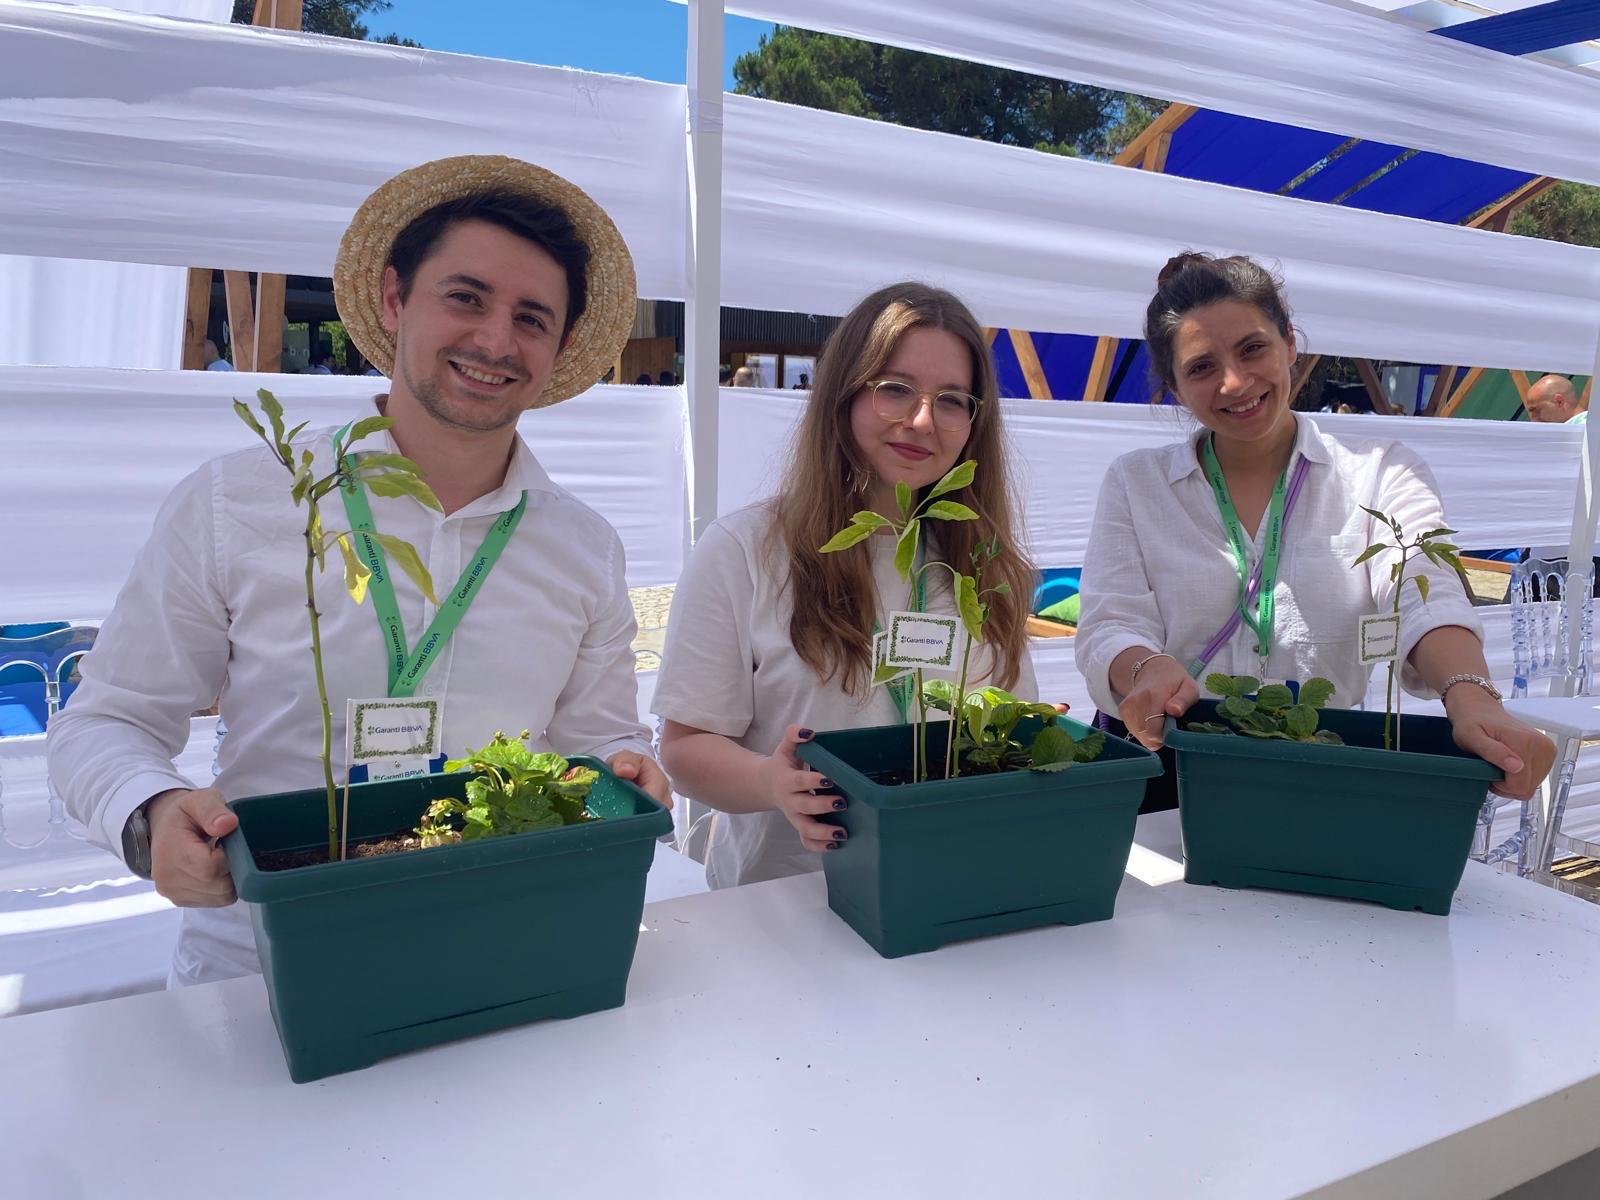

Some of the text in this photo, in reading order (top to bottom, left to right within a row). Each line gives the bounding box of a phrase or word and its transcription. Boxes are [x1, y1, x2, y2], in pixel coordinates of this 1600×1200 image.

[370, 559, 384, 583] BBVA
[458, 556, 488, 599] Garanti BBVA
[391, 624, 404, 675] Garanti BBV
[407, 632, 441, 678] Garanti BBVA
[375, 725, 423, 734] Garanti BBVA
